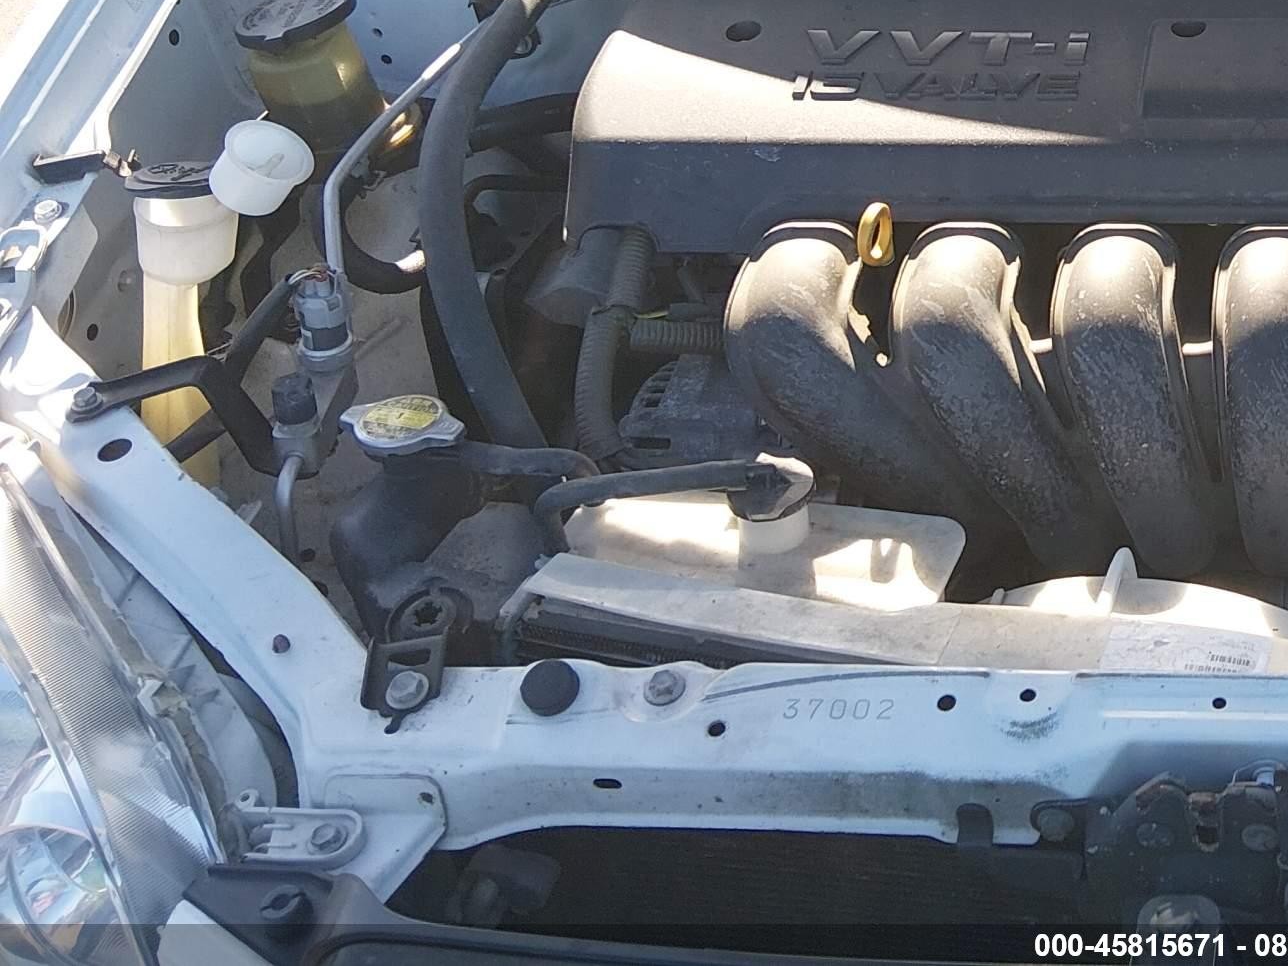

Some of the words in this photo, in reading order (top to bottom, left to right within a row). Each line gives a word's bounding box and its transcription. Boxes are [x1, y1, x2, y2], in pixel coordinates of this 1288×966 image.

[806, 28, 1090, 66] VVT-i
[873, 71, 1081, 101] VALVE
[782, 697, 895, 721] 37002
